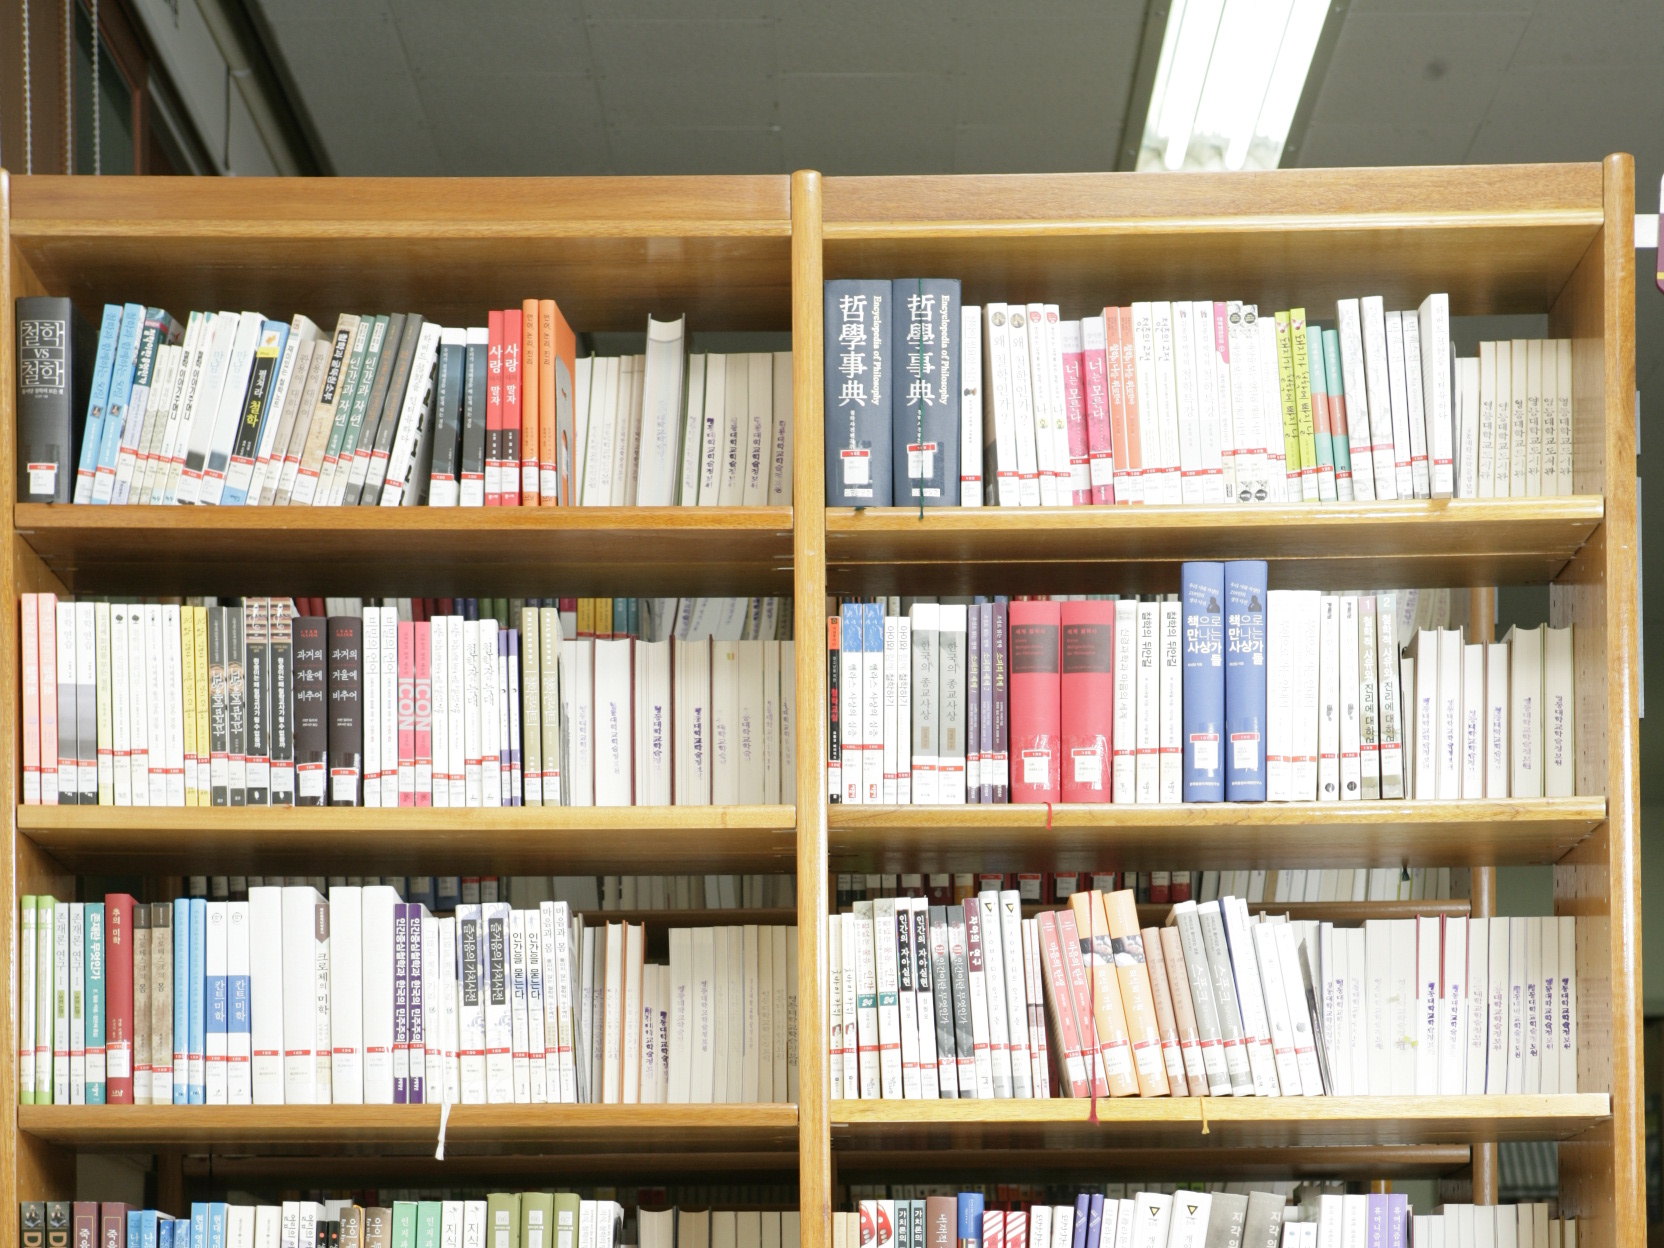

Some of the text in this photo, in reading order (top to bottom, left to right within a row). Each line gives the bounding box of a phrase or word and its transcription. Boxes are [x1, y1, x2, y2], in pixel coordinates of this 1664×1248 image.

[22, 322, 64, 346] 철학
[1137, 317, 1150, 361] 청춘의 고전
[35, 349, 49, 358] VS
[490, 344, 503, 373] 사랑
[505, 343, 519, 373] 사랑
[839, 294, 867, 406] 哲學事典
[871, 296, 882, 405] Encyclopedia of Philosophy
[939, 295, 950, 405] Encyclopedia of Philosophy
[22, 361, 64, 385] 철학
[335, 357, 359, 427] 인간과 자연
[350, 357, 375, 427] 인간과 자연
[491, 386, 500, 405] 말자
[507, 384, 516, 404] 말자
[1067, 361, 1081, 422] 너는 모른다
[1384, 598, 1390, 607] 2
[1187, 615, 1222, 626] 책으로
[1187, 628, 1222, 639] 만나는
[1228, 628, 1263, 639] 만나는
[1229, 615, 1263, 626] 책으로
[364, 616, 377, 674] 비밀의 언어
[1119, 628, 1130, 671] 신경과학과
[1142, 612, 1152, 666] 철학의 뒤안길
[1188, 641, 1222, 653] 사상가
[1229, 640, 1264, 653] 사상가
[297, 650, 322, 660] 과거의
[332, 649, 357, 659] 과거의
[1211, 654, 1222, 666] 들
[1252, 654, 1264, 666] 들
[297, 670, 322, 681] 거울에
[333, 670, 357, 680] 거울에
[921, 641, 933, 720] 한국의 종교사상
[1119, 673, 1130, 700] 마음의
[298, 690, 322, 701] 비추어
[333, 690, 357, 701] 비추어
[399, 679, 414, 731] ICON
[416, 679, 431, 731] ICON
[525, 674, 537, 724] 철학콘서트
[112, 908, 120, 945] 추의 미학
[900, 916, 908, 943] 인간의
[969, 916, 979, 943] 자아의
[57, 913, 65, 971] 존재론 연구
[91, 913, 100, 980] 존재란 무엇인가
[463, 923, 477, 1002] 즐거움의 가치사전
[1050, 941, 1065, 986] 마음의 탄생
[396, 917, 406, 1042] 인간중심철학과 한국의 민주주의
[937, 957, 949, 1025] 인간이란 무엇인가
[1190, 964, 1207, 1003] 스푸크
[1215, 964, 1230, 1004] 스푸크
[214, 980, 225, 1022] 칸트 미학
[235, 980, 246, 1021] 칸트 미학
[862, 998, 873, 1006] 24
[195, 1215, 203, 1232] 현대
[349, 1219, 357, 1239] 아이
[899, 1210, 907, 1242] 가치론의
[936, 1214, 947, 1243] 내재적
[1372, 1206, 1383, 1248] 휴머니즘의
